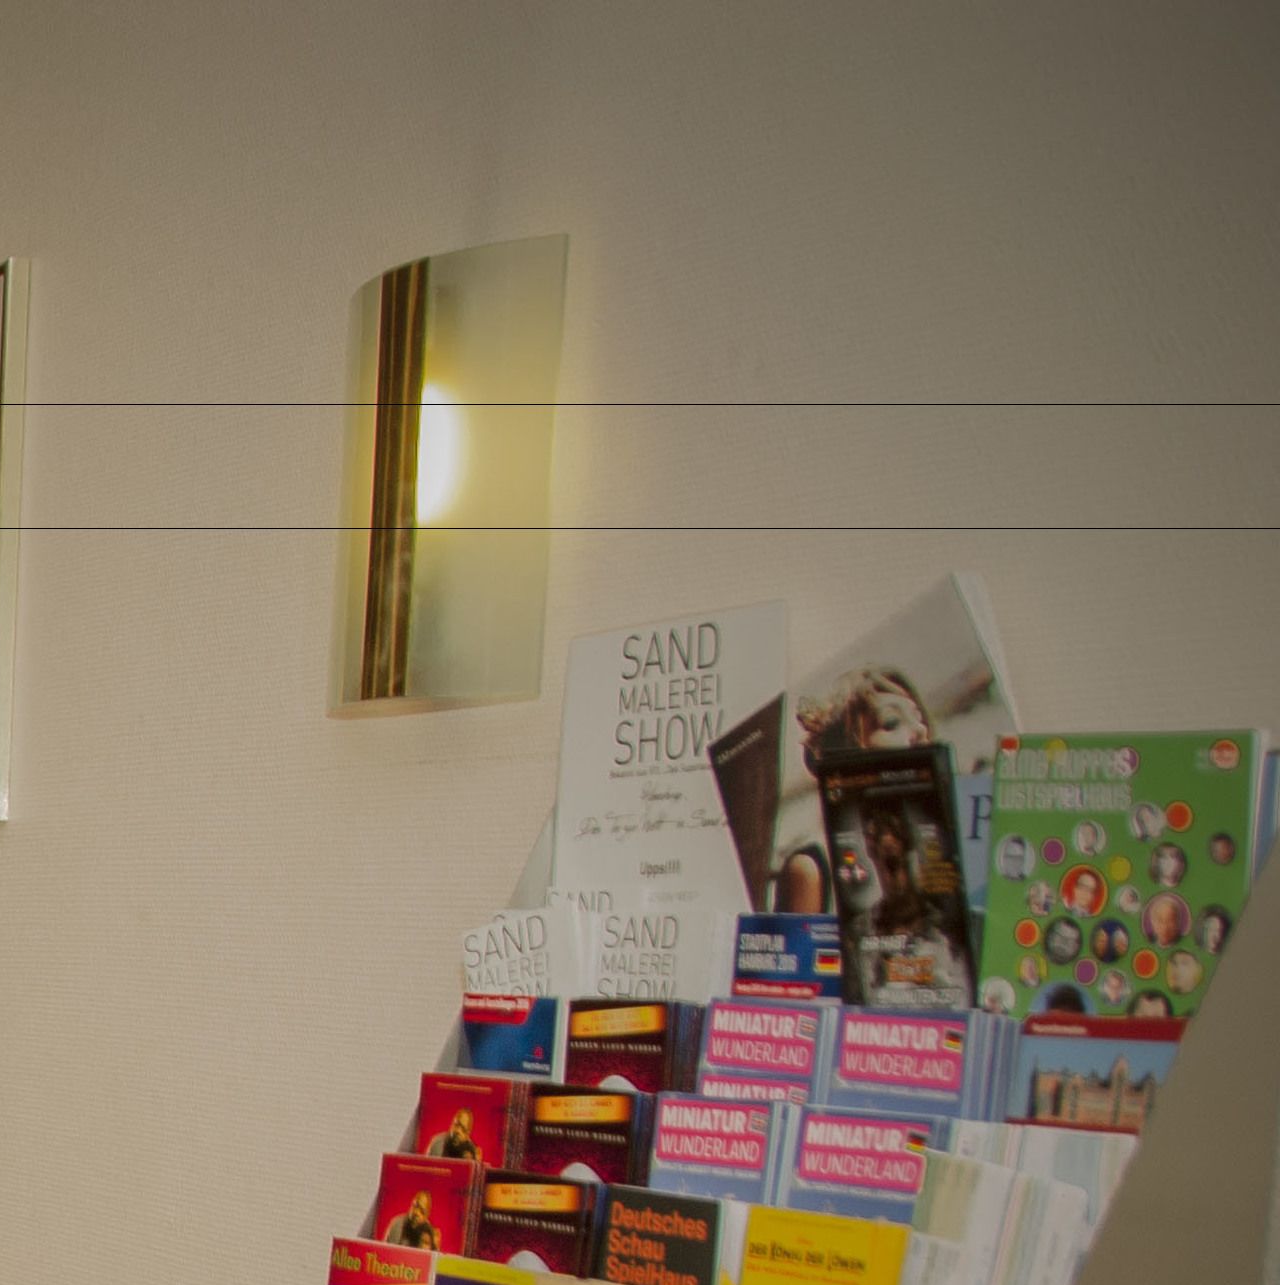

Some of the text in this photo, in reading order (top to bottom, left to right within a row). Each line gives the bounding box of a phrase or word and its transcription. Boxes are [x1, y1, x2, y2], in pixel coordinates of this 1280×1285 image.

[621, 622, 720, 680] SAND
[618, 673, 722, 715] MALEREI
[614, 709, 724, 765] SHOW
[464, 914, 547, 969] SAND
[603, 915, 679, 949] SAND
[600, 952, 676, 976] MALEREI
[713, 1009, 795, 1038] MINIATUR
[846, 1021, 939, 1051] MINIATUR
[711, 1037, 809, 1068] WUNDERLAND
[844, 1051, 956, 1083] WUNDERLAND
[662, 1104, 747, 1134] MINIATUR
[660, 1133, 760, 1164] WUNDERLAND
[806, 1120, 903, 1152] MINIATUR
[804, 1151, 918, 1183] WUNDERLAND
[611, 1201, 707, 1241] Deutsches
[607, 1229, 666, 1262] Schau
[332, 1247, 421, 1282] Allee Theater
